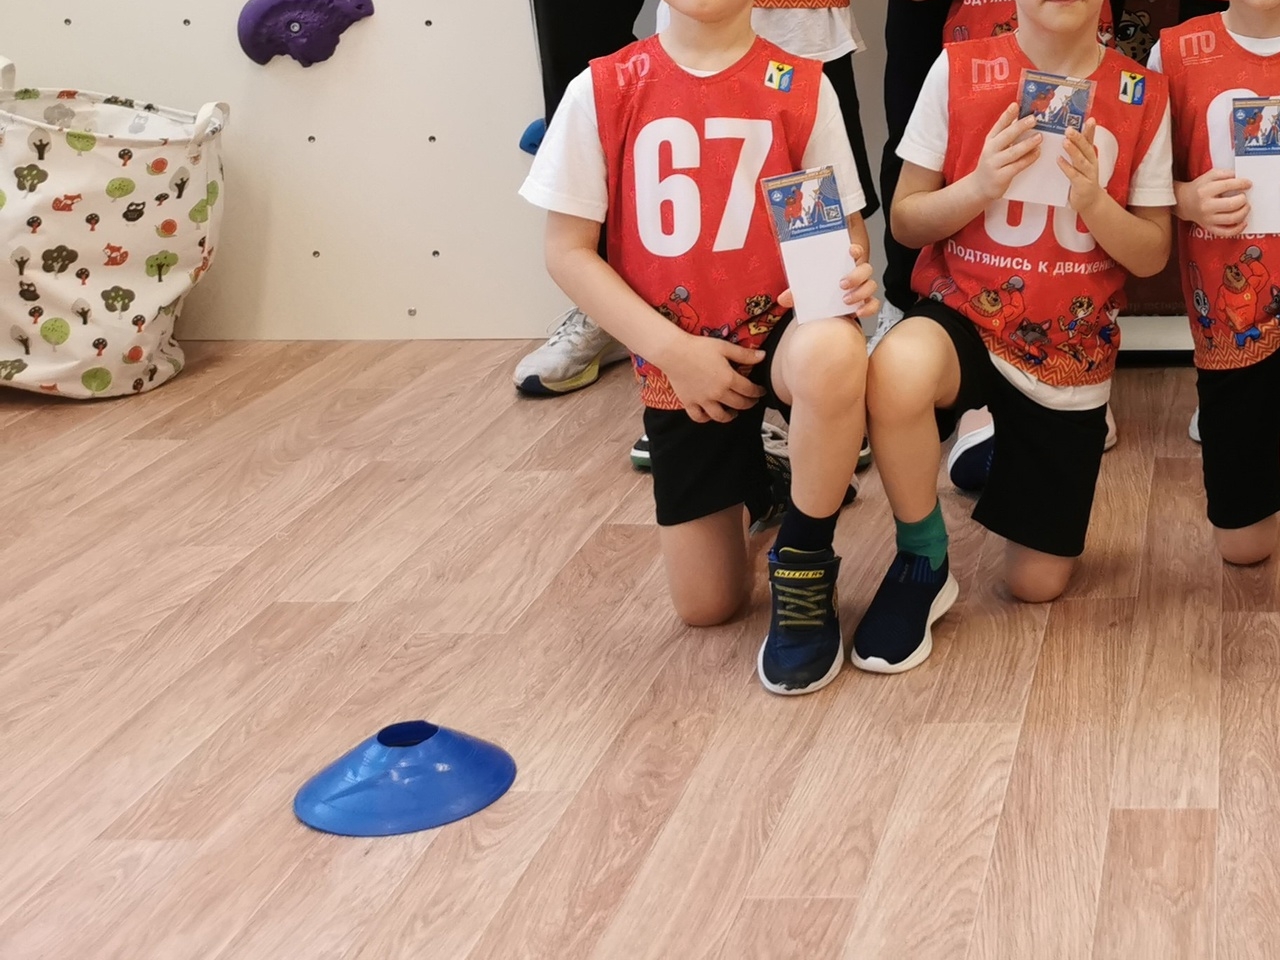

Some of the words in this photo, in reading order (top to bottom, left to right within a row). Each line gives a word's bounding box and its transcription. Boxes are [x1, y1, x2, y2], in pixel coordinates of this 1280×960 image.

[1179, 30, 1216, 58] ГТО
[971, 56, 1010, 84] ГТО
[633, 116, 774, 258] 67
[947, 239, 1032, 272] Подтянись
[1038, 260, 1049, 273] к
[774, 569, 825, 579] SKECHERS
